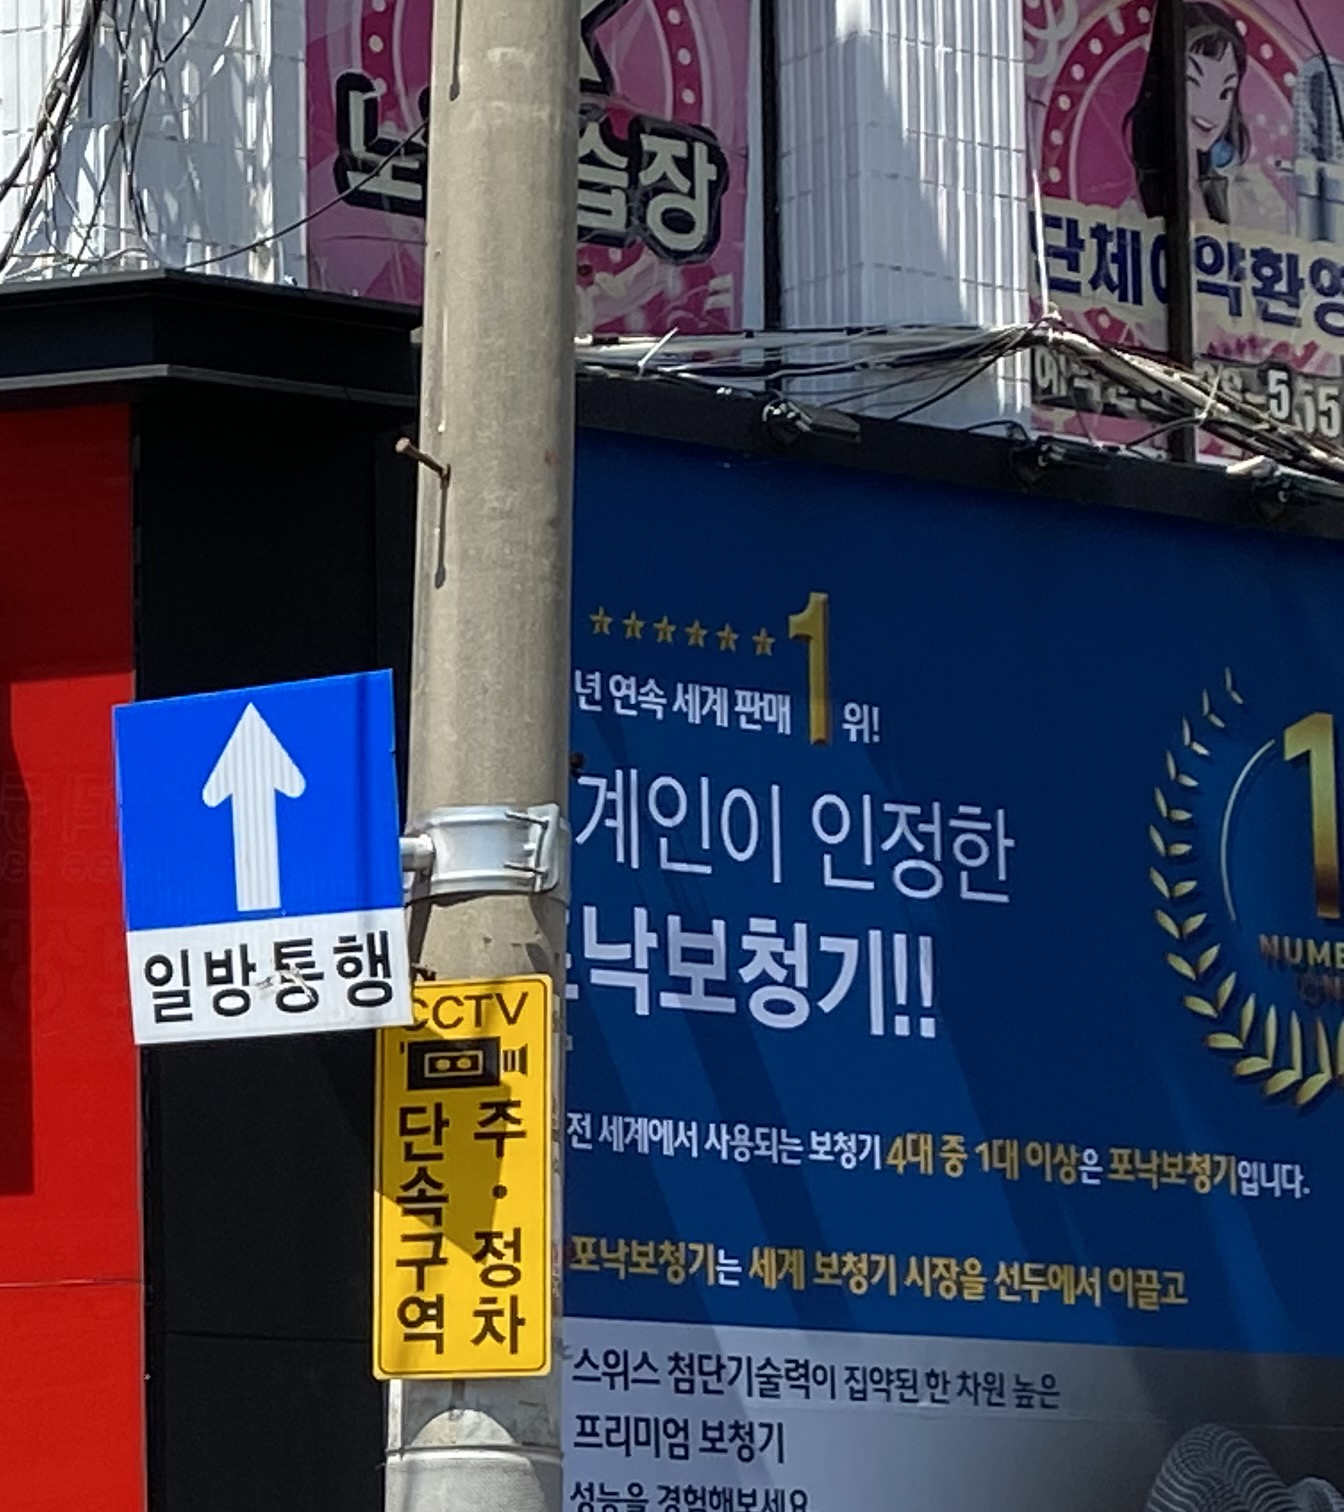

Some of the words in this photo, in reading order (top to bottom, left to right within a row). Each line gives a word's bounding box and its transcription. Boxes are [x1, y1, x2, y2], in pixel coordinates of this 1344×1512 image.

[608, 673, 667, 721] 연속
[671, 682, 729, 728] 세계
[733, 688, 792, 735] 판매
[811, 791, 1017, 904] 인정한
[141, 928, 394, 1025] 일방통행
[565, 903, 938, 1040] 낙보청기!!
[566, 1111, 593, 1150] 전
[598, 1112, 699, 1158] 세계에서
[703, 1122, 804, 1165] 사용되는
[808, 1130, 882, 1170] 보청기
[885, 1132, 933, 1175] 4대
[939, 1133, 969, 1178] 중
[974, 1138, 1020, 1180] 1대
[1025, 1139, 1103, 1186] 이상은
[395, 1101, 450, 1356] 단속구역
[569, 1234, 744, 1288] 포낙보청기는
[748, 1246, 805, 1290] 세계
[813, 1250, 897, 1297] 보청기
[904, 1254, 987, 1301] 시장을
[994, 1258, 1102, 1307] 선두에서
[1110, 1266, 1190, 1311] 이끌고
[571, 1347, 662, 1392] 스위스
[666, 1351, 838, 1402] 첨단기술력이
[843, 1364, 919, 1403] 집약된
[925, 1367, 952, 1404] 한
[956, 1368, 1008, 1408] 차원
[1012, 1373, 1062, 1410] 높은
[572, 1413, 691, 1461] 프리미엄
[698, 1419, 787, 1465] 보청기
